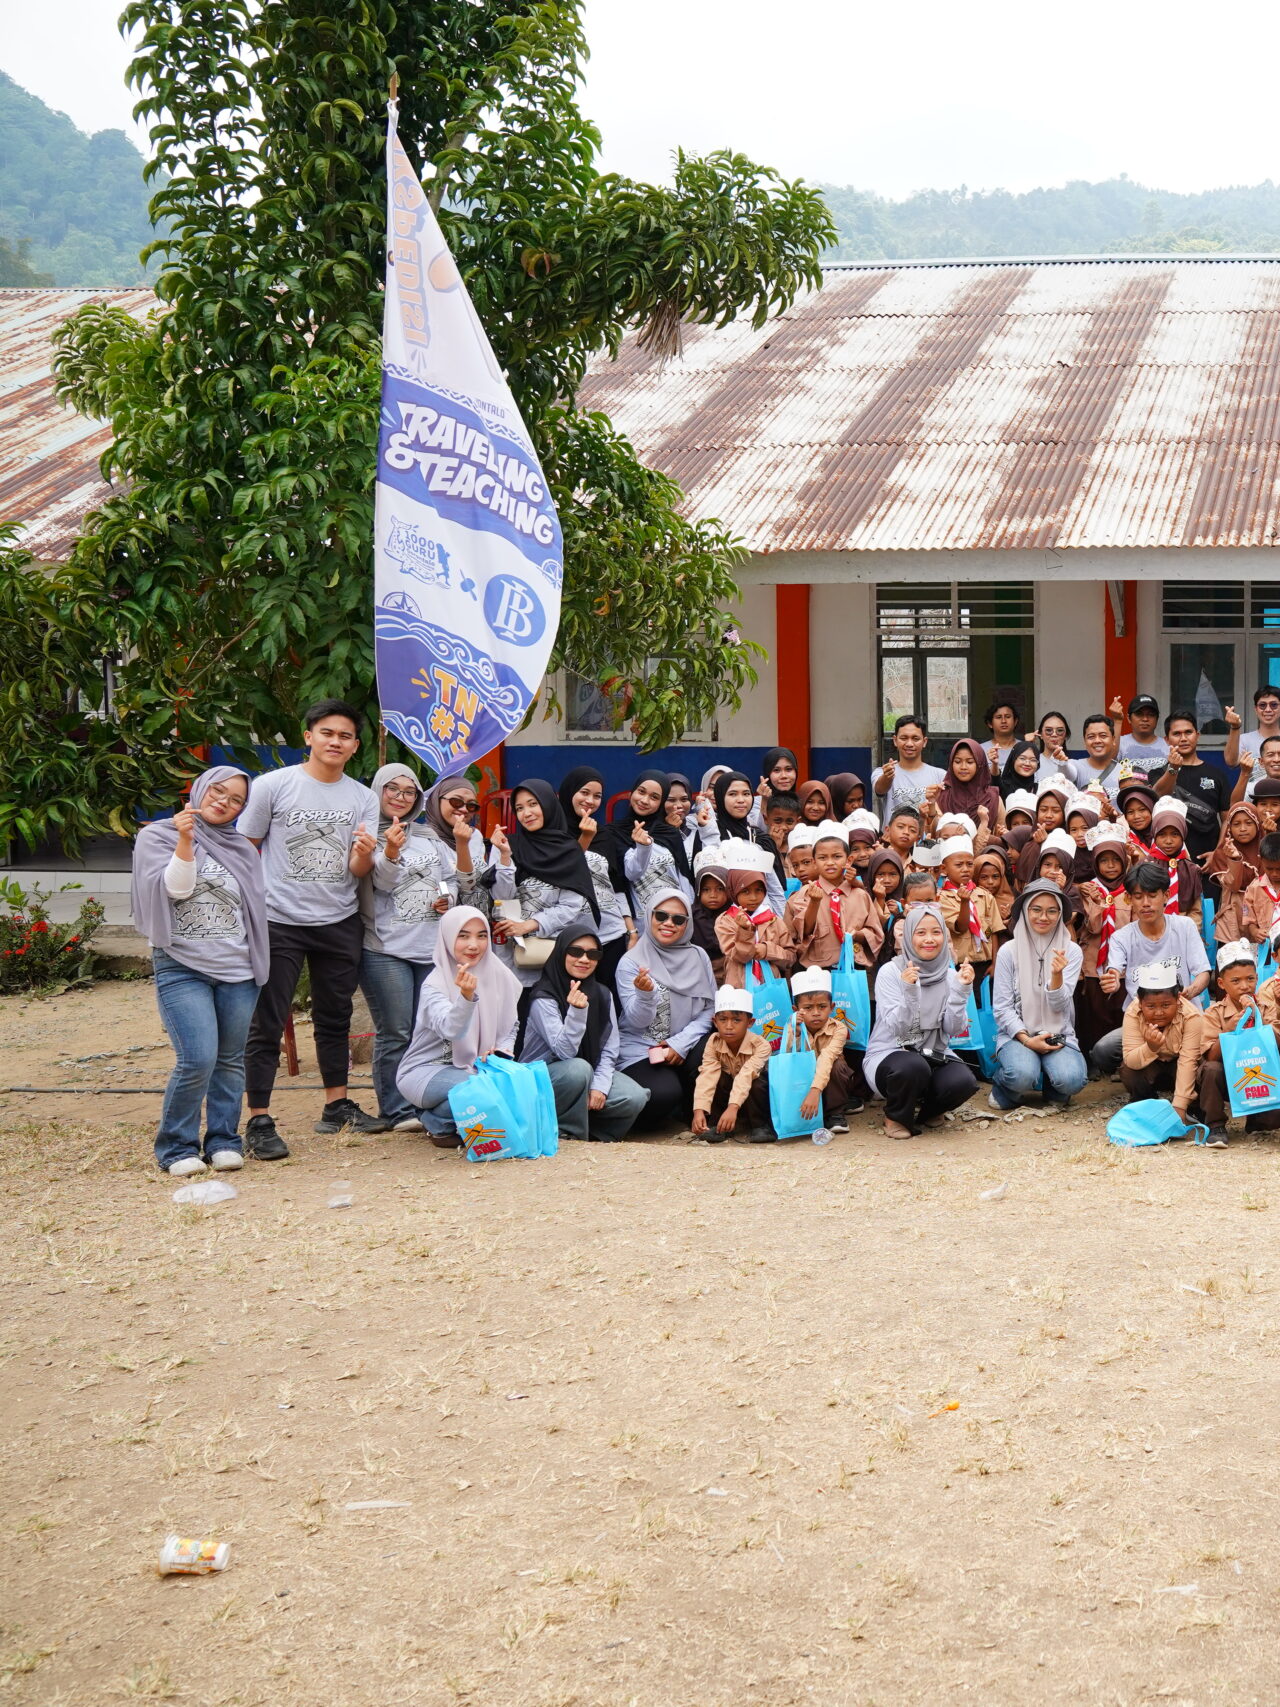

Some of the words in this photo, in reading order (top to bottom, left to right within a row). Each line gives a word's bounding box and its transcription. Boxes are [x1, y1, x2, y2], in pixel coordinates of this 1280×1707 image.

[397, 401, 544, 503] TRAVELING
[405, 530, 435, 550] 1000
[405, 540, 435, 560] GURU
[434, 667, 484, 725] TN
[286, 809, 354, 828] EKSPEDISI
